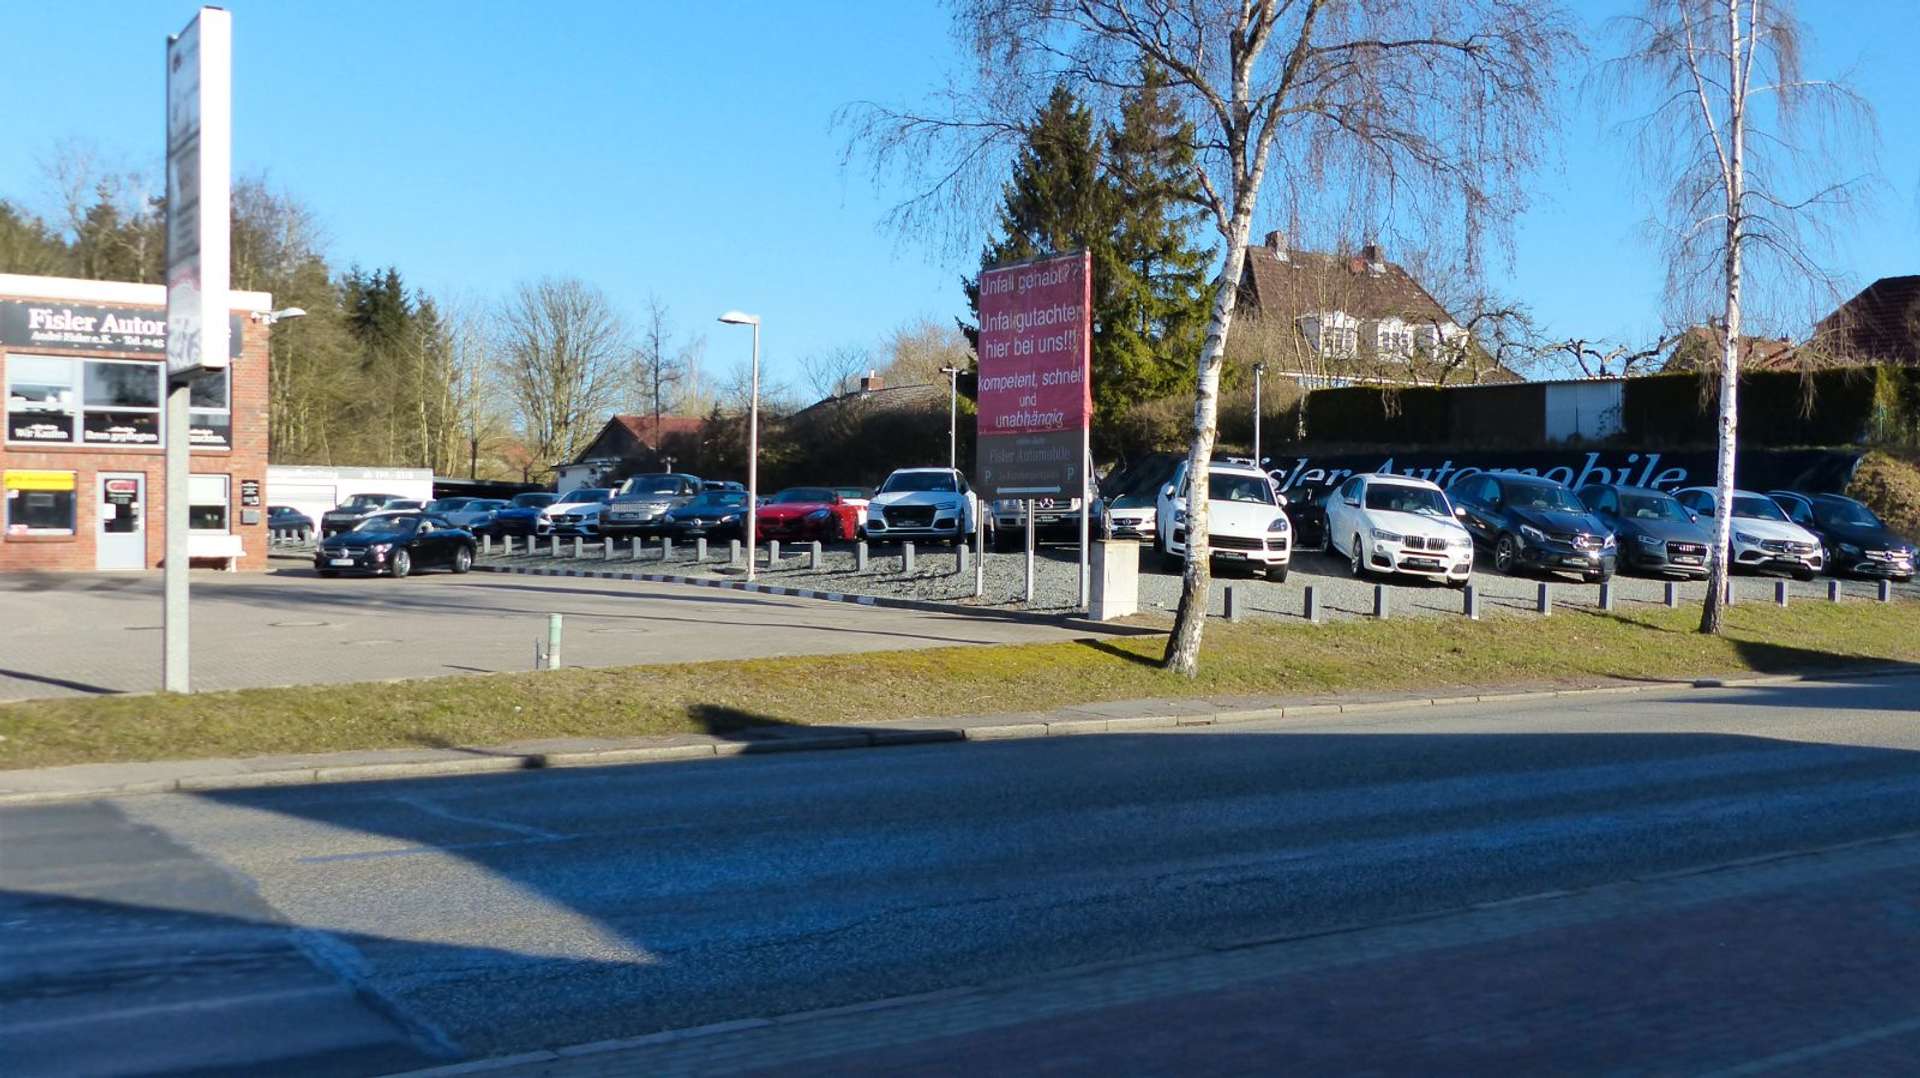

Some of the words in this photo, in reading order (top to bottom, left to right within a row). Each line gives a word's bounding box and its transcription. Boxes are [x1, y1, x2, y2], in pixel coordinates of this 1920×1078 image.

[980, 272, 1015, 296] Unfall
[29, 308, 97, 332] Fisler
[985, 338, 1010, 360] hier
[1014, 335, 1035, 357] bei
[978, 371, 1038, 393] kompetent,
[1042, 366, 1085, 386] schnell
[1020, 392, 1037, 407] und
[996, 408, 1064, 429] unabhängig
[985, 470, 992, 481] P
[1067, 464, 1075, 481] P
